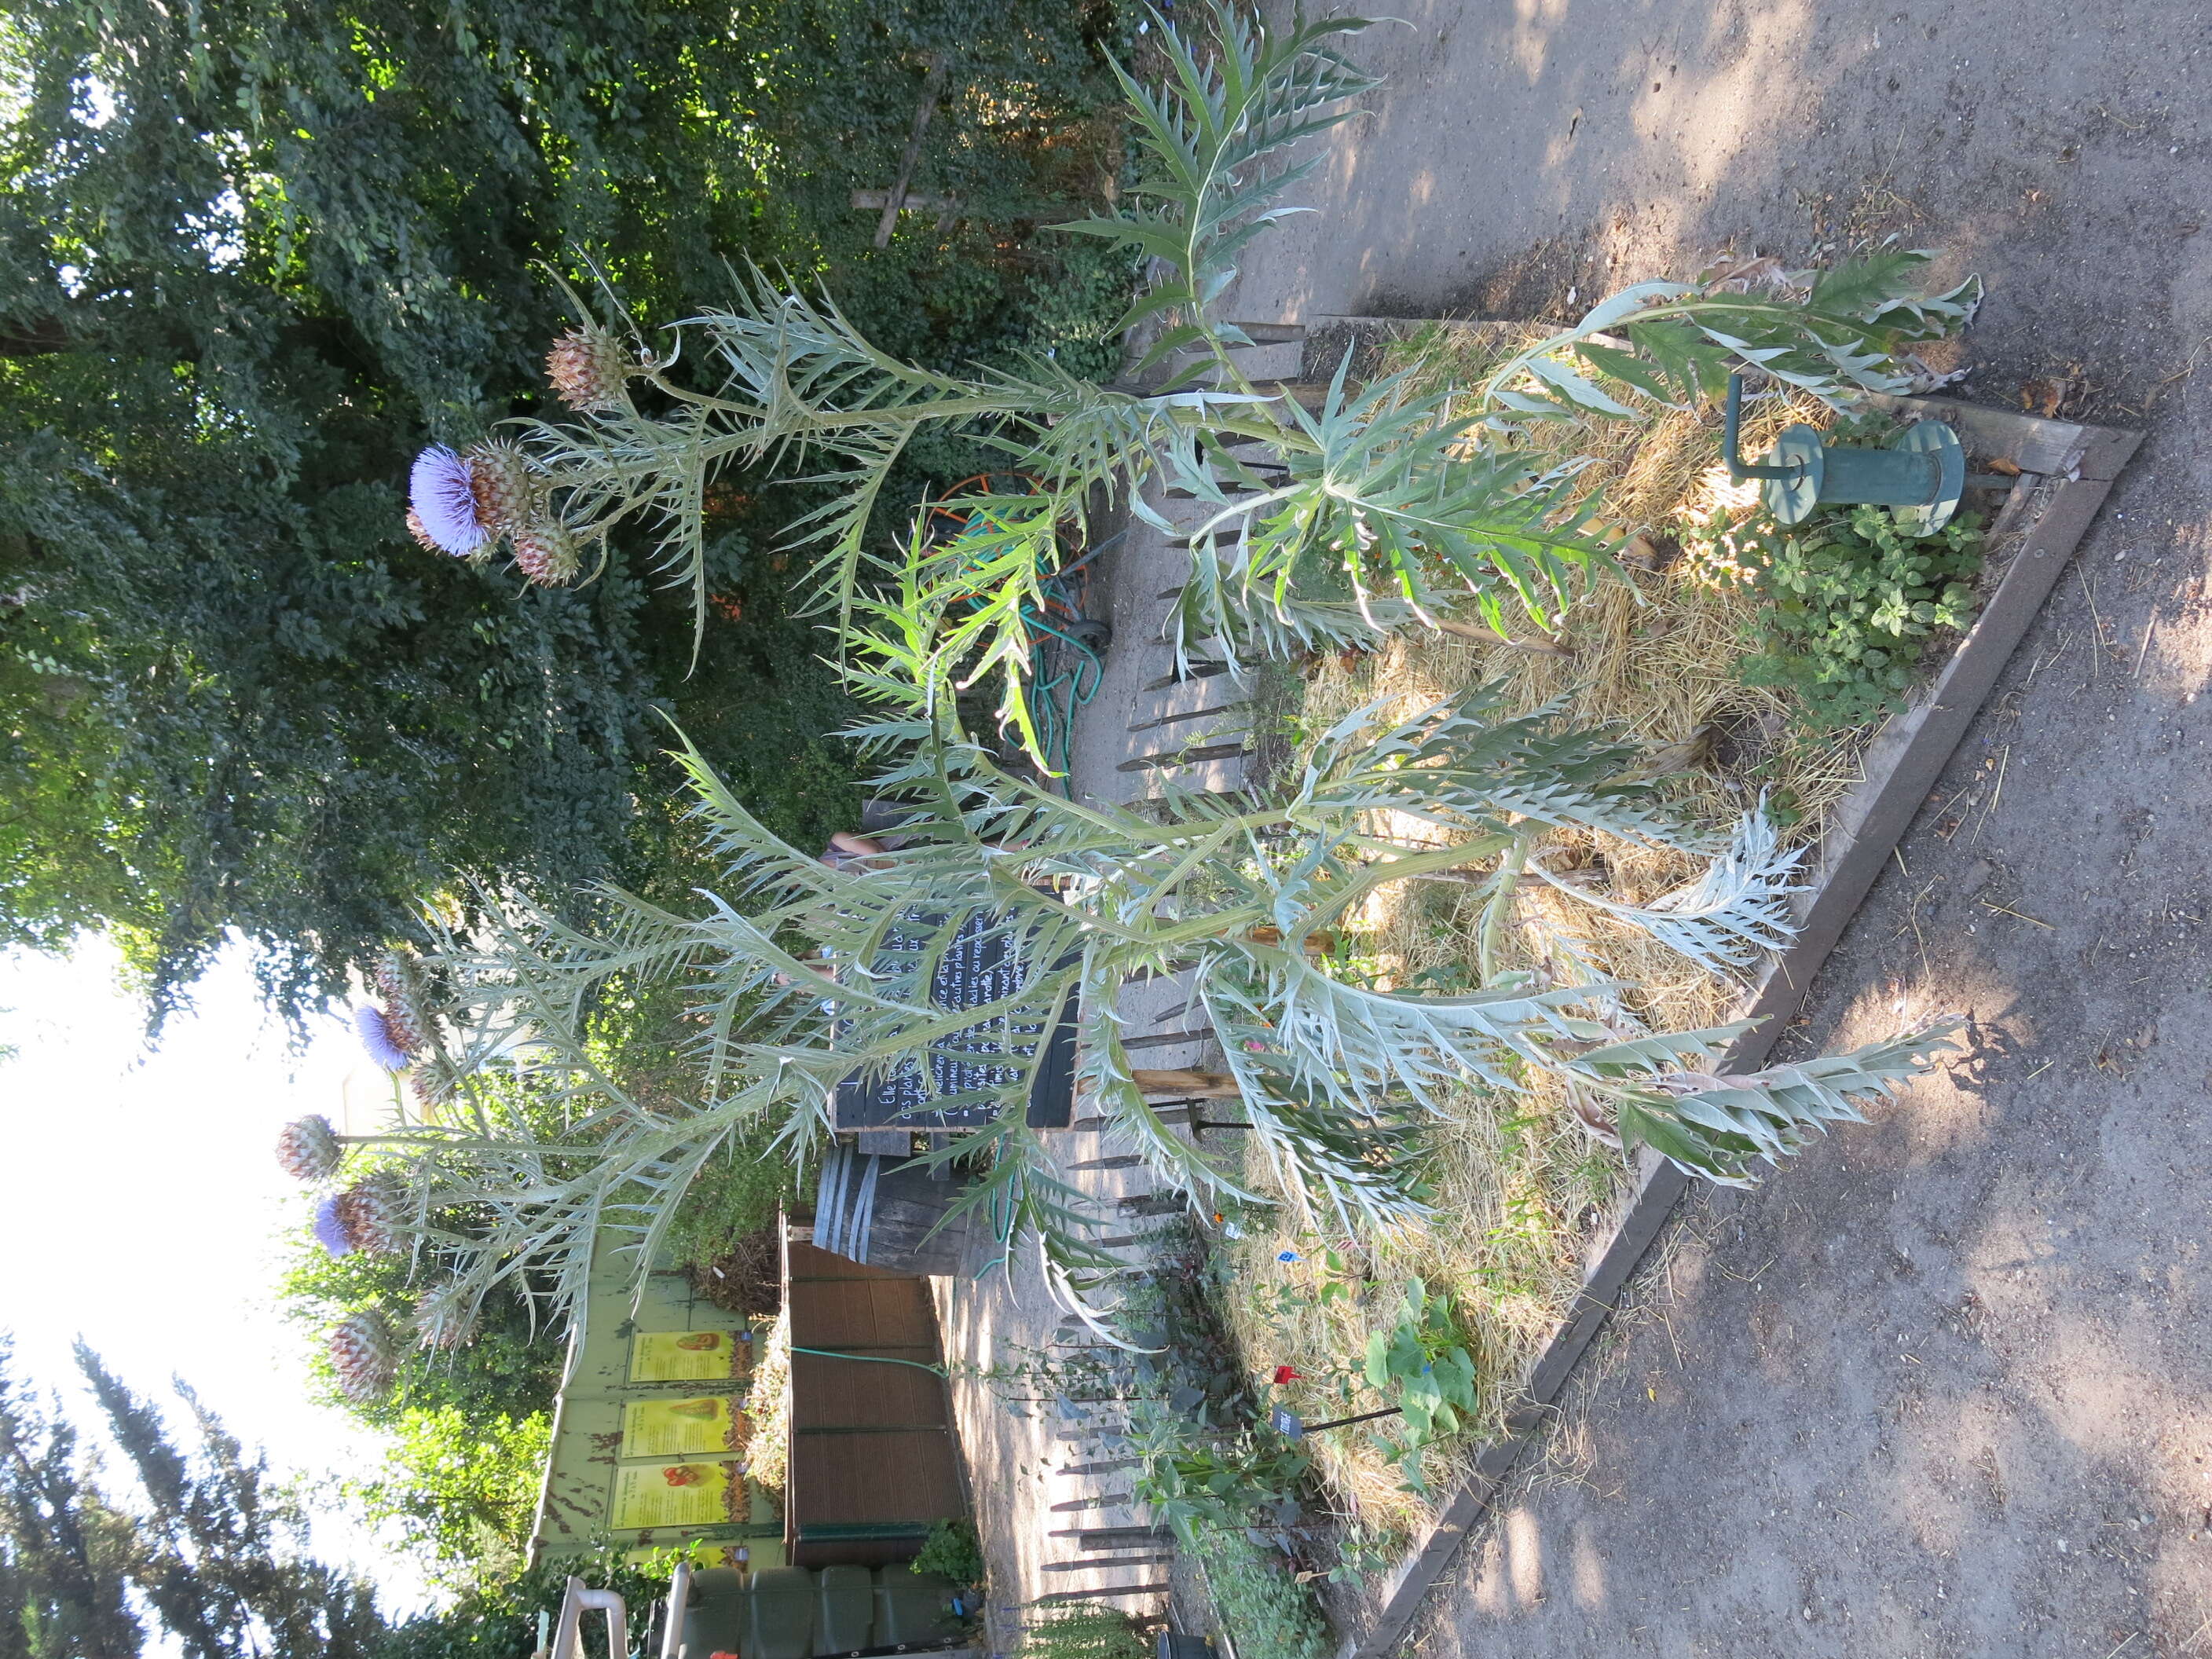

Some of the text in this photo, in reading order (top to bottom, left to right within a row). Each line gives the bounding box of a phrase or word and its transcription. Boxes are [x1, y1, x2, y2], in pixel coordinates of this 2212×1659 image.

[973, 961, 980, 972] ou
[950, 972, 961, 1002] autres
[877, 1093, 896, 1104] Elle
